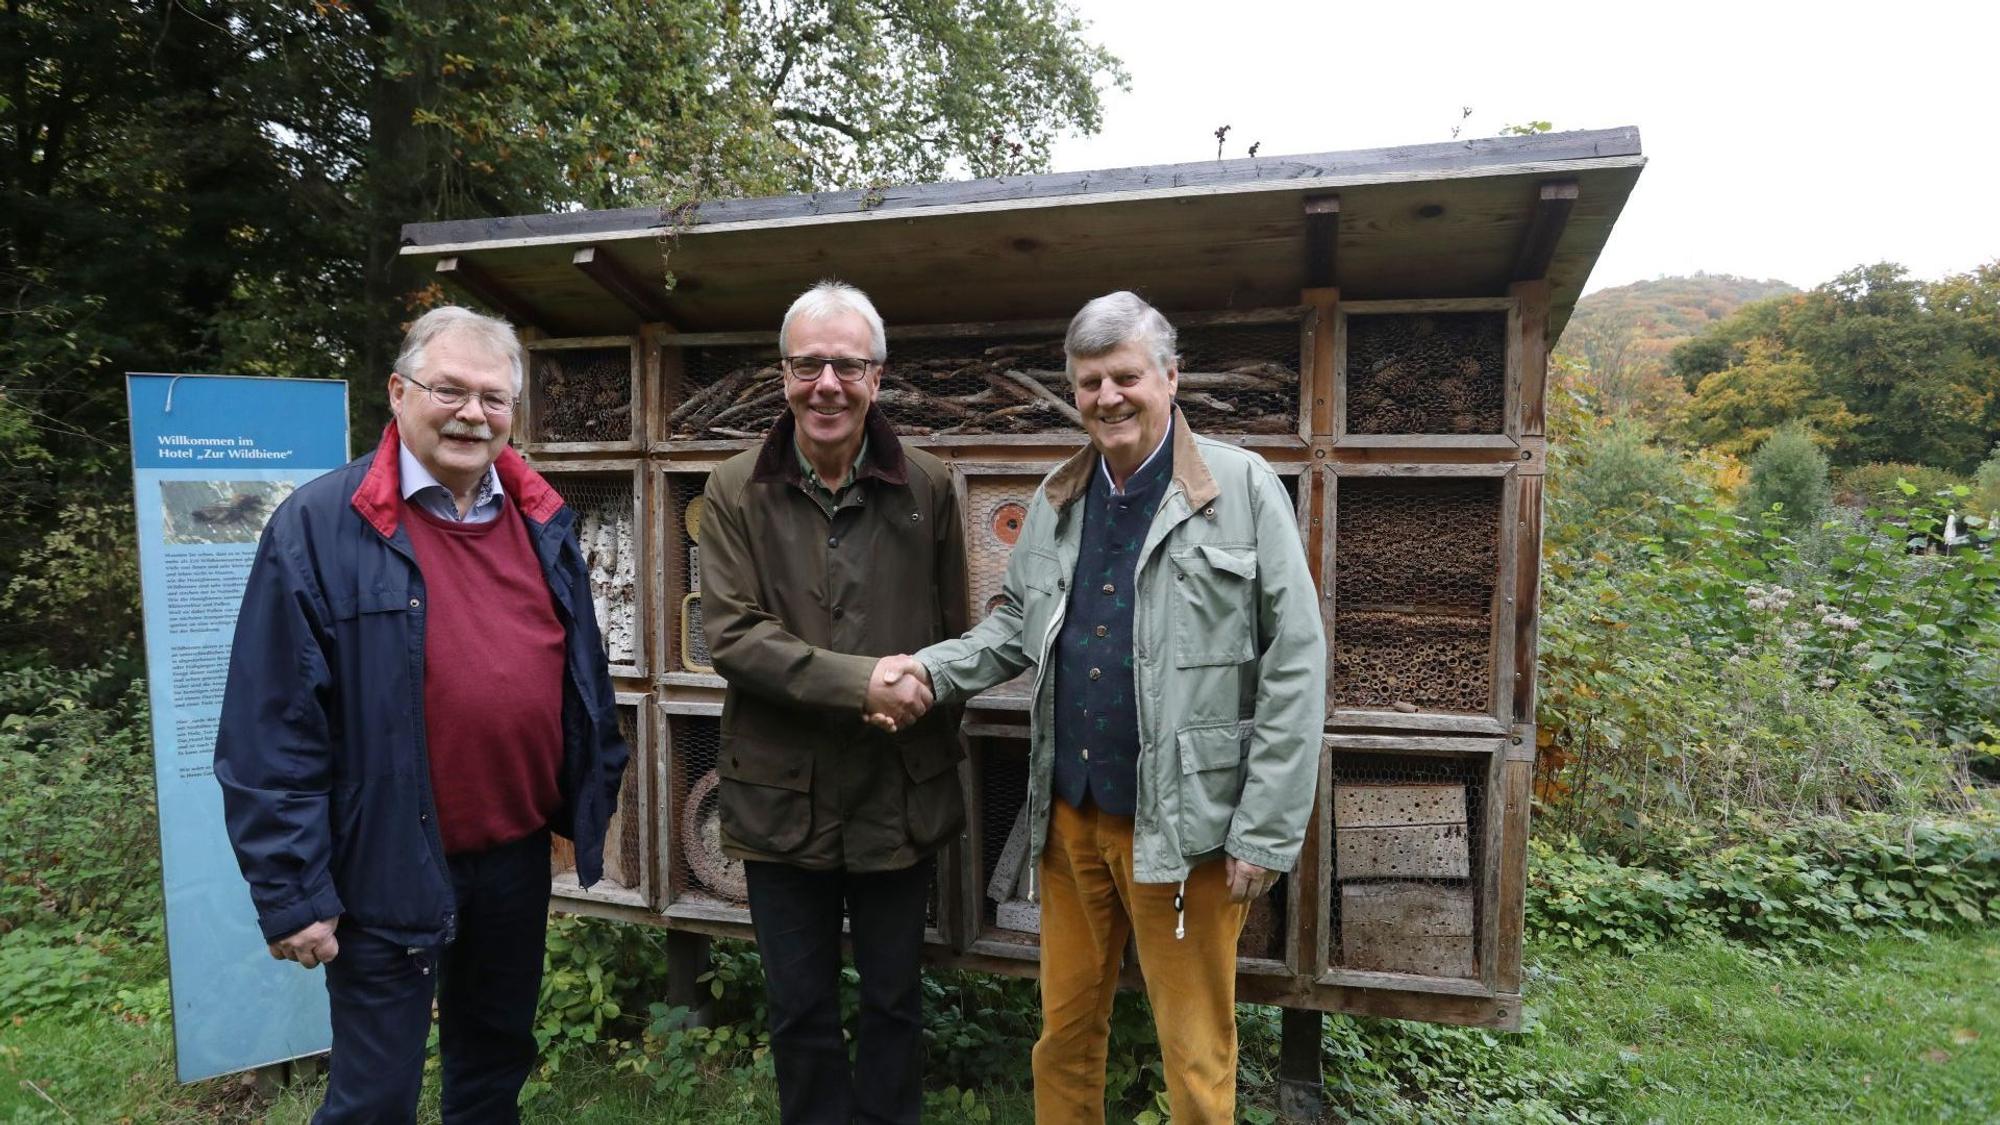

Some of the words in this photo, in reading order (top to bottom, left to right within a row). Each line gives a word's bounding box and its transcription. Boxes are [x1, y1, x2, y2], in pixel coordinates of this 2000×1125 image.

[158, 435, 235, 446] Willkommen
[238, 436, 254, 446] im
[159, 448, 193, 458] Hotel
[197, 448, 225, 460] „Zur
[227, 449, 293, 459] Wildbiene“
